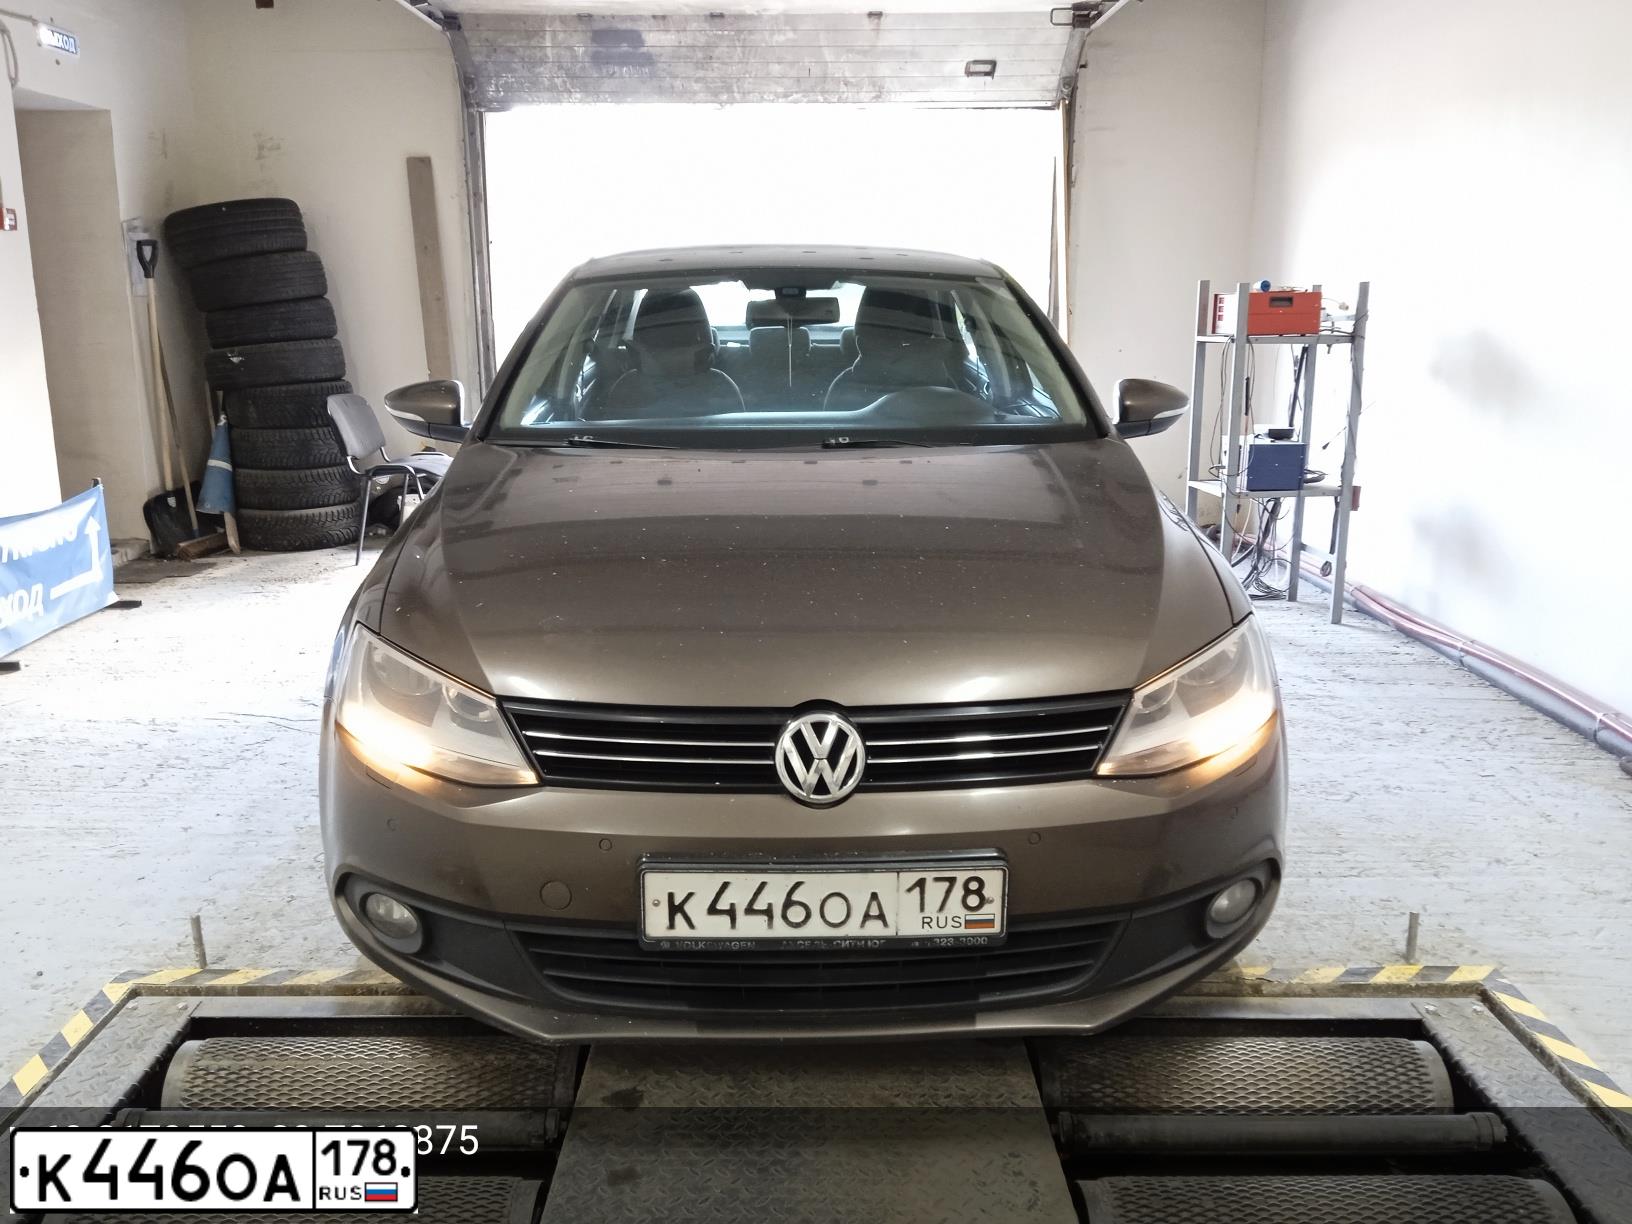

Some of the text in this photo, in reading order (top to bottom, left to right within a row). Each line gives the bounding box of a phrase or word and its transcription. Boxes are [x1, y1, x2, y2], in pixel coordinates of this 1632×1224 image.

[44, 29, 76, 53] ЫХОД
[666, 875, 986, 930] К446ОА 178
[921, 915, 963, 929] RUS
